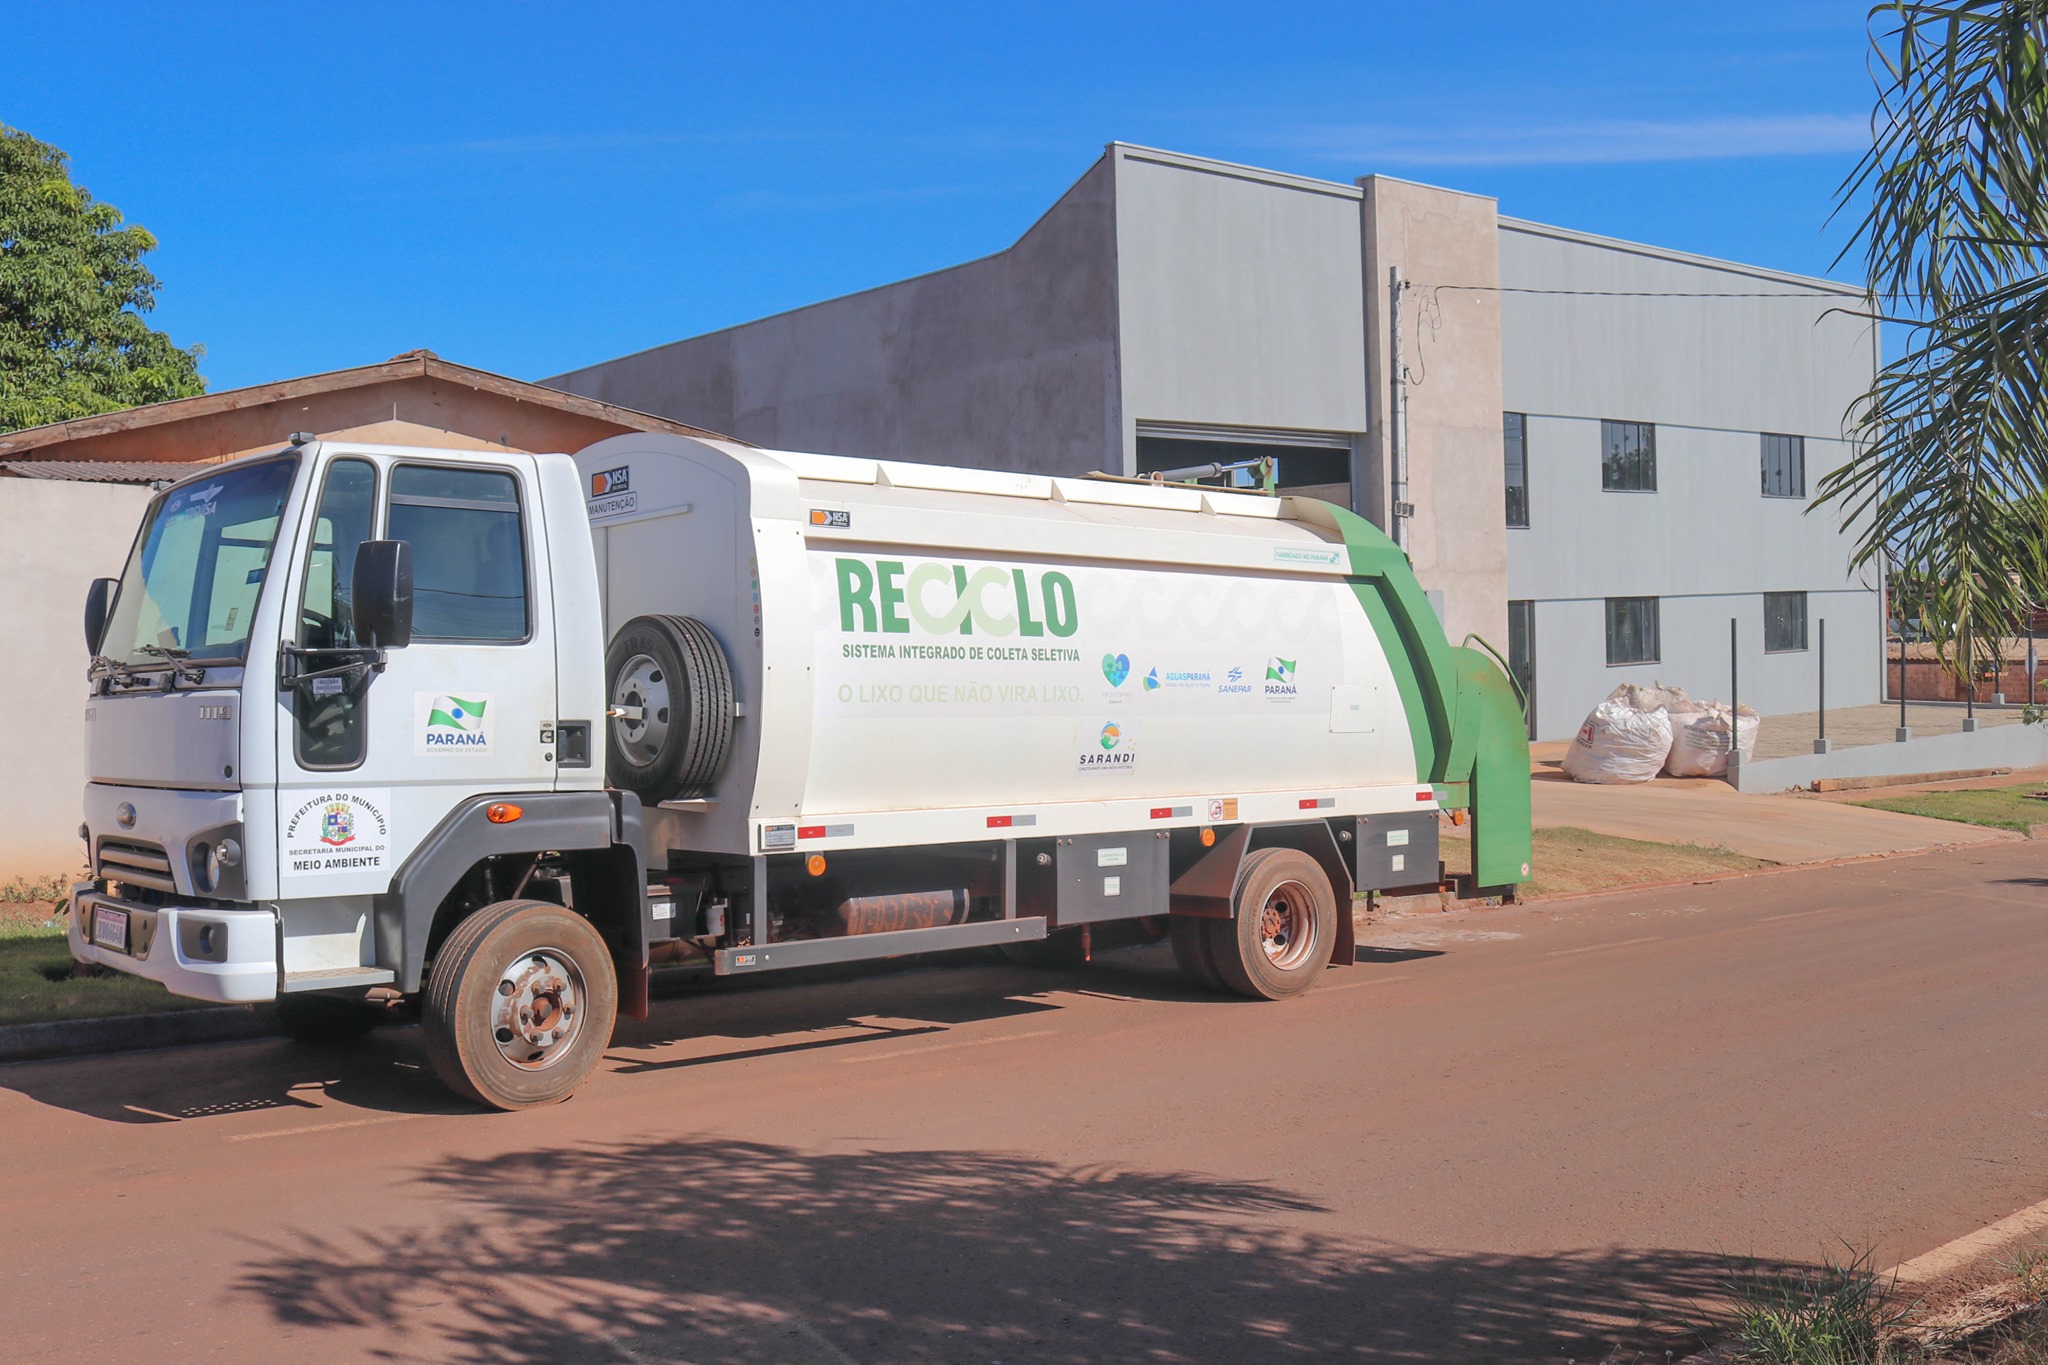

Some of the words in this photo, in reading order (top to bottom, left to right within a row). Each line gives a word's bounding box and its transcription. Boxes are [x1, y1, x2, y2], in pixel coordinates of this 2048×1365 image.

[612, 469, 628, 485] NSA
[588, 496, 635, 514] MANUTENÇÃO
[832, 512, 848, 522] NSA
[1276, 552, 1302, 560] FABRICADO
[834, 558, 1078, 638] RECICLO
[842, 644, 896, 659] SISTEMA
[899, 645, 966, 660] INTEGRADO
[969, 646, 984, 660] DE
[986, 646, 1029, 661] COLETA
[1031, 648, 1080, 662] SELETIVA
[838, 684, 853, 703] O
[859, 684, 904, 703] LIXO
[909, 684, 948, 704] QUE
[954, 681, 996, 703] NÃO
[998, 685, 1038, 703] VIRA
[1042, 686, 1084, 703] LIXO.
[1218, 685, 1252, 693] SANEPAR
[1264, 684, 1297, 694] PARANÁ
[200, 706, 232, 720] 1119
[426, 731, 486, 746] PARANÁ
[1080, 754, 1135, 764] SARANDI
[287, 794, 333, 838] PREFEITURA
[351, 796, 387, 836] MUNICÍPIO
[289, 846, 334, 856] SECRETARIA
[294, 860, 322, 871] MEIO
[324, 856, 380, 869] AMBIENTE
